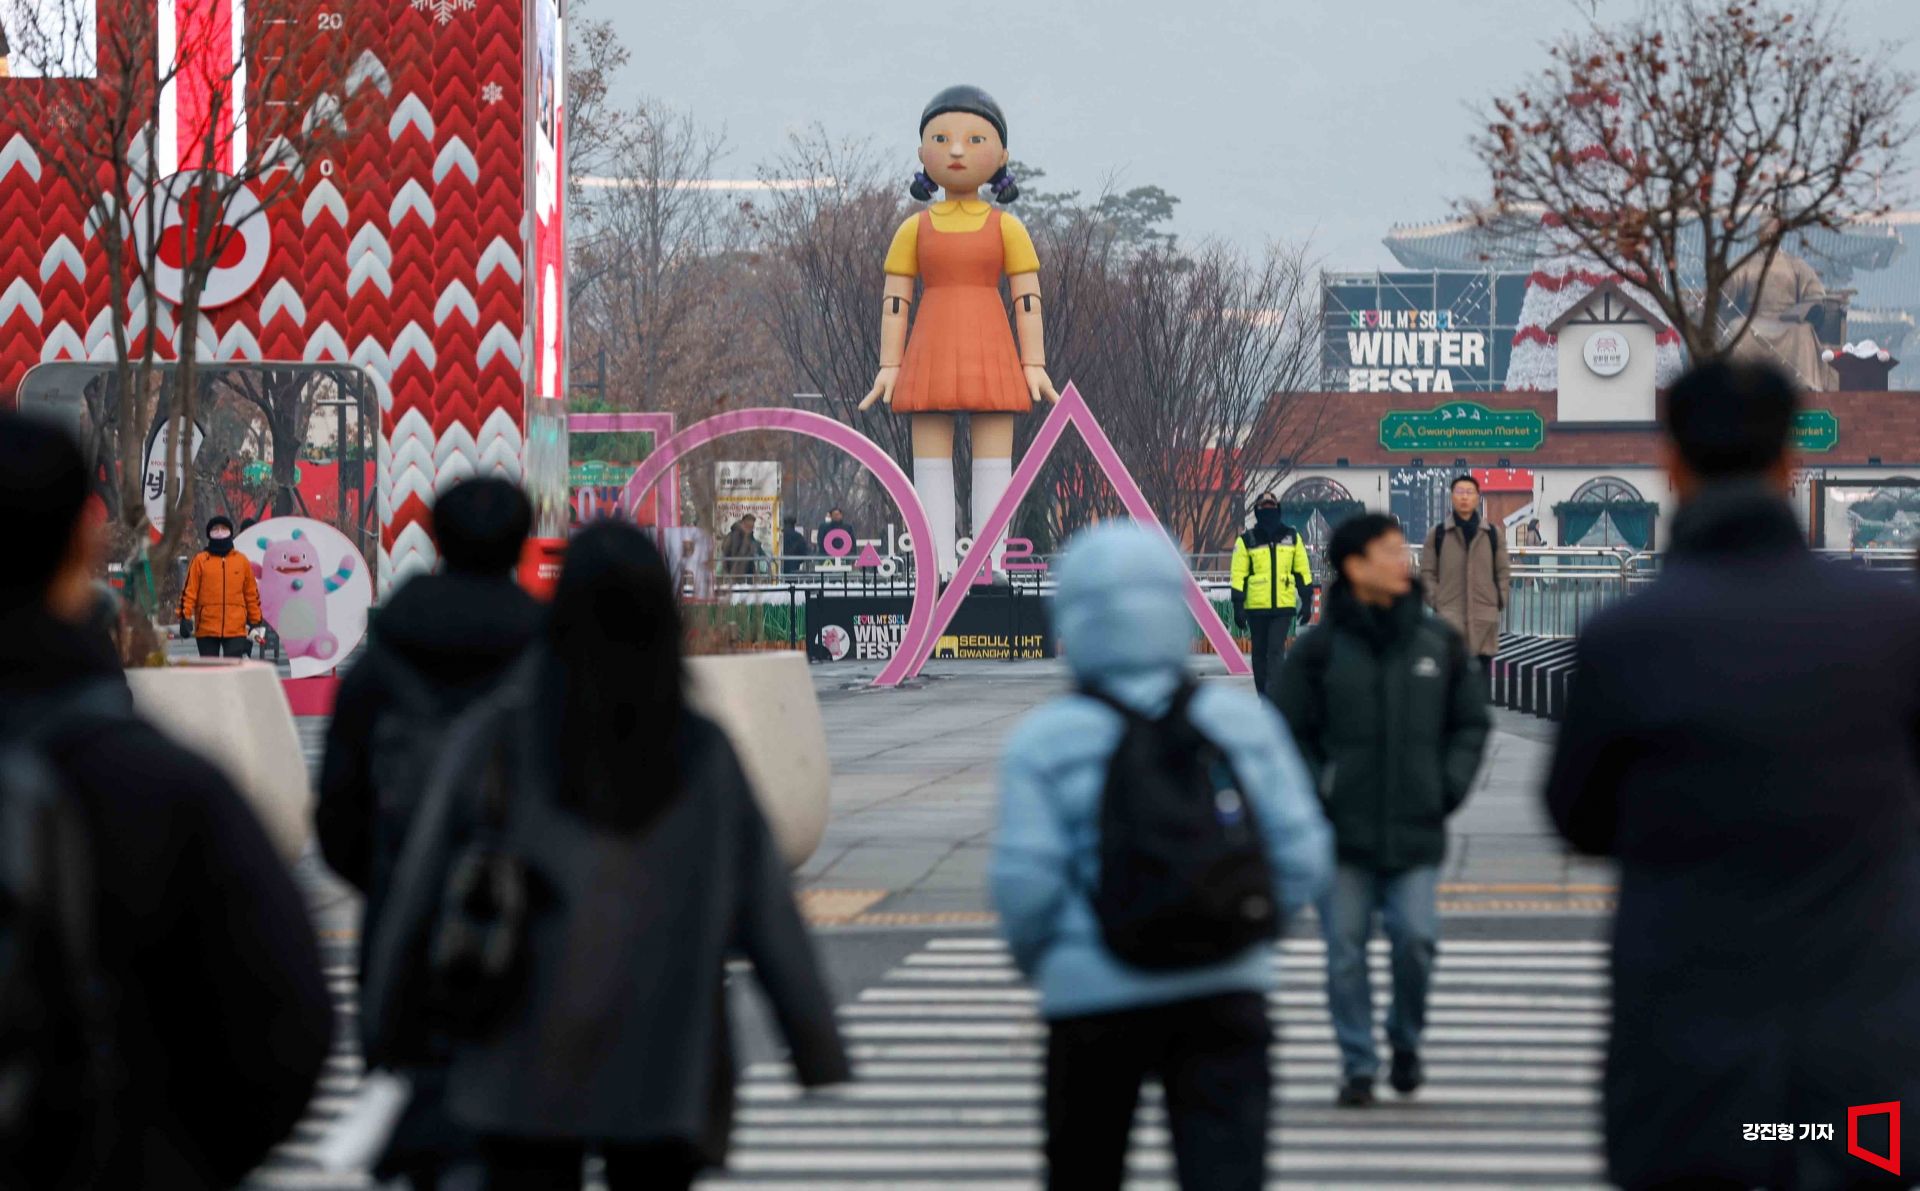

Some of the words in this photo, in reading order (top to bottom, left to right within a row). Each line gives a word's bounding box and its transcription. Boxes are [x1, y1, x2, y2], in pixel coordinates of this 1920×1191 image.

[318, 13, 343, 30] 20
[320, 160, 334, 176] 0
[1350, 309, 1394, 328] SEOUL
[1397, 309, 1419, 329] MY
[1420, 309, 1455, 328] SOUL
[1347, 331, 1485, 366] WINTER
[1418, 426, 1493, 437] Gwanghwamun
[1495, 425, 1530, 436] Market
[853, 614, 875, 625] SEOUL
[888, 614, 905, 625] SOUL
[856, 642, 899, 660] FEST
